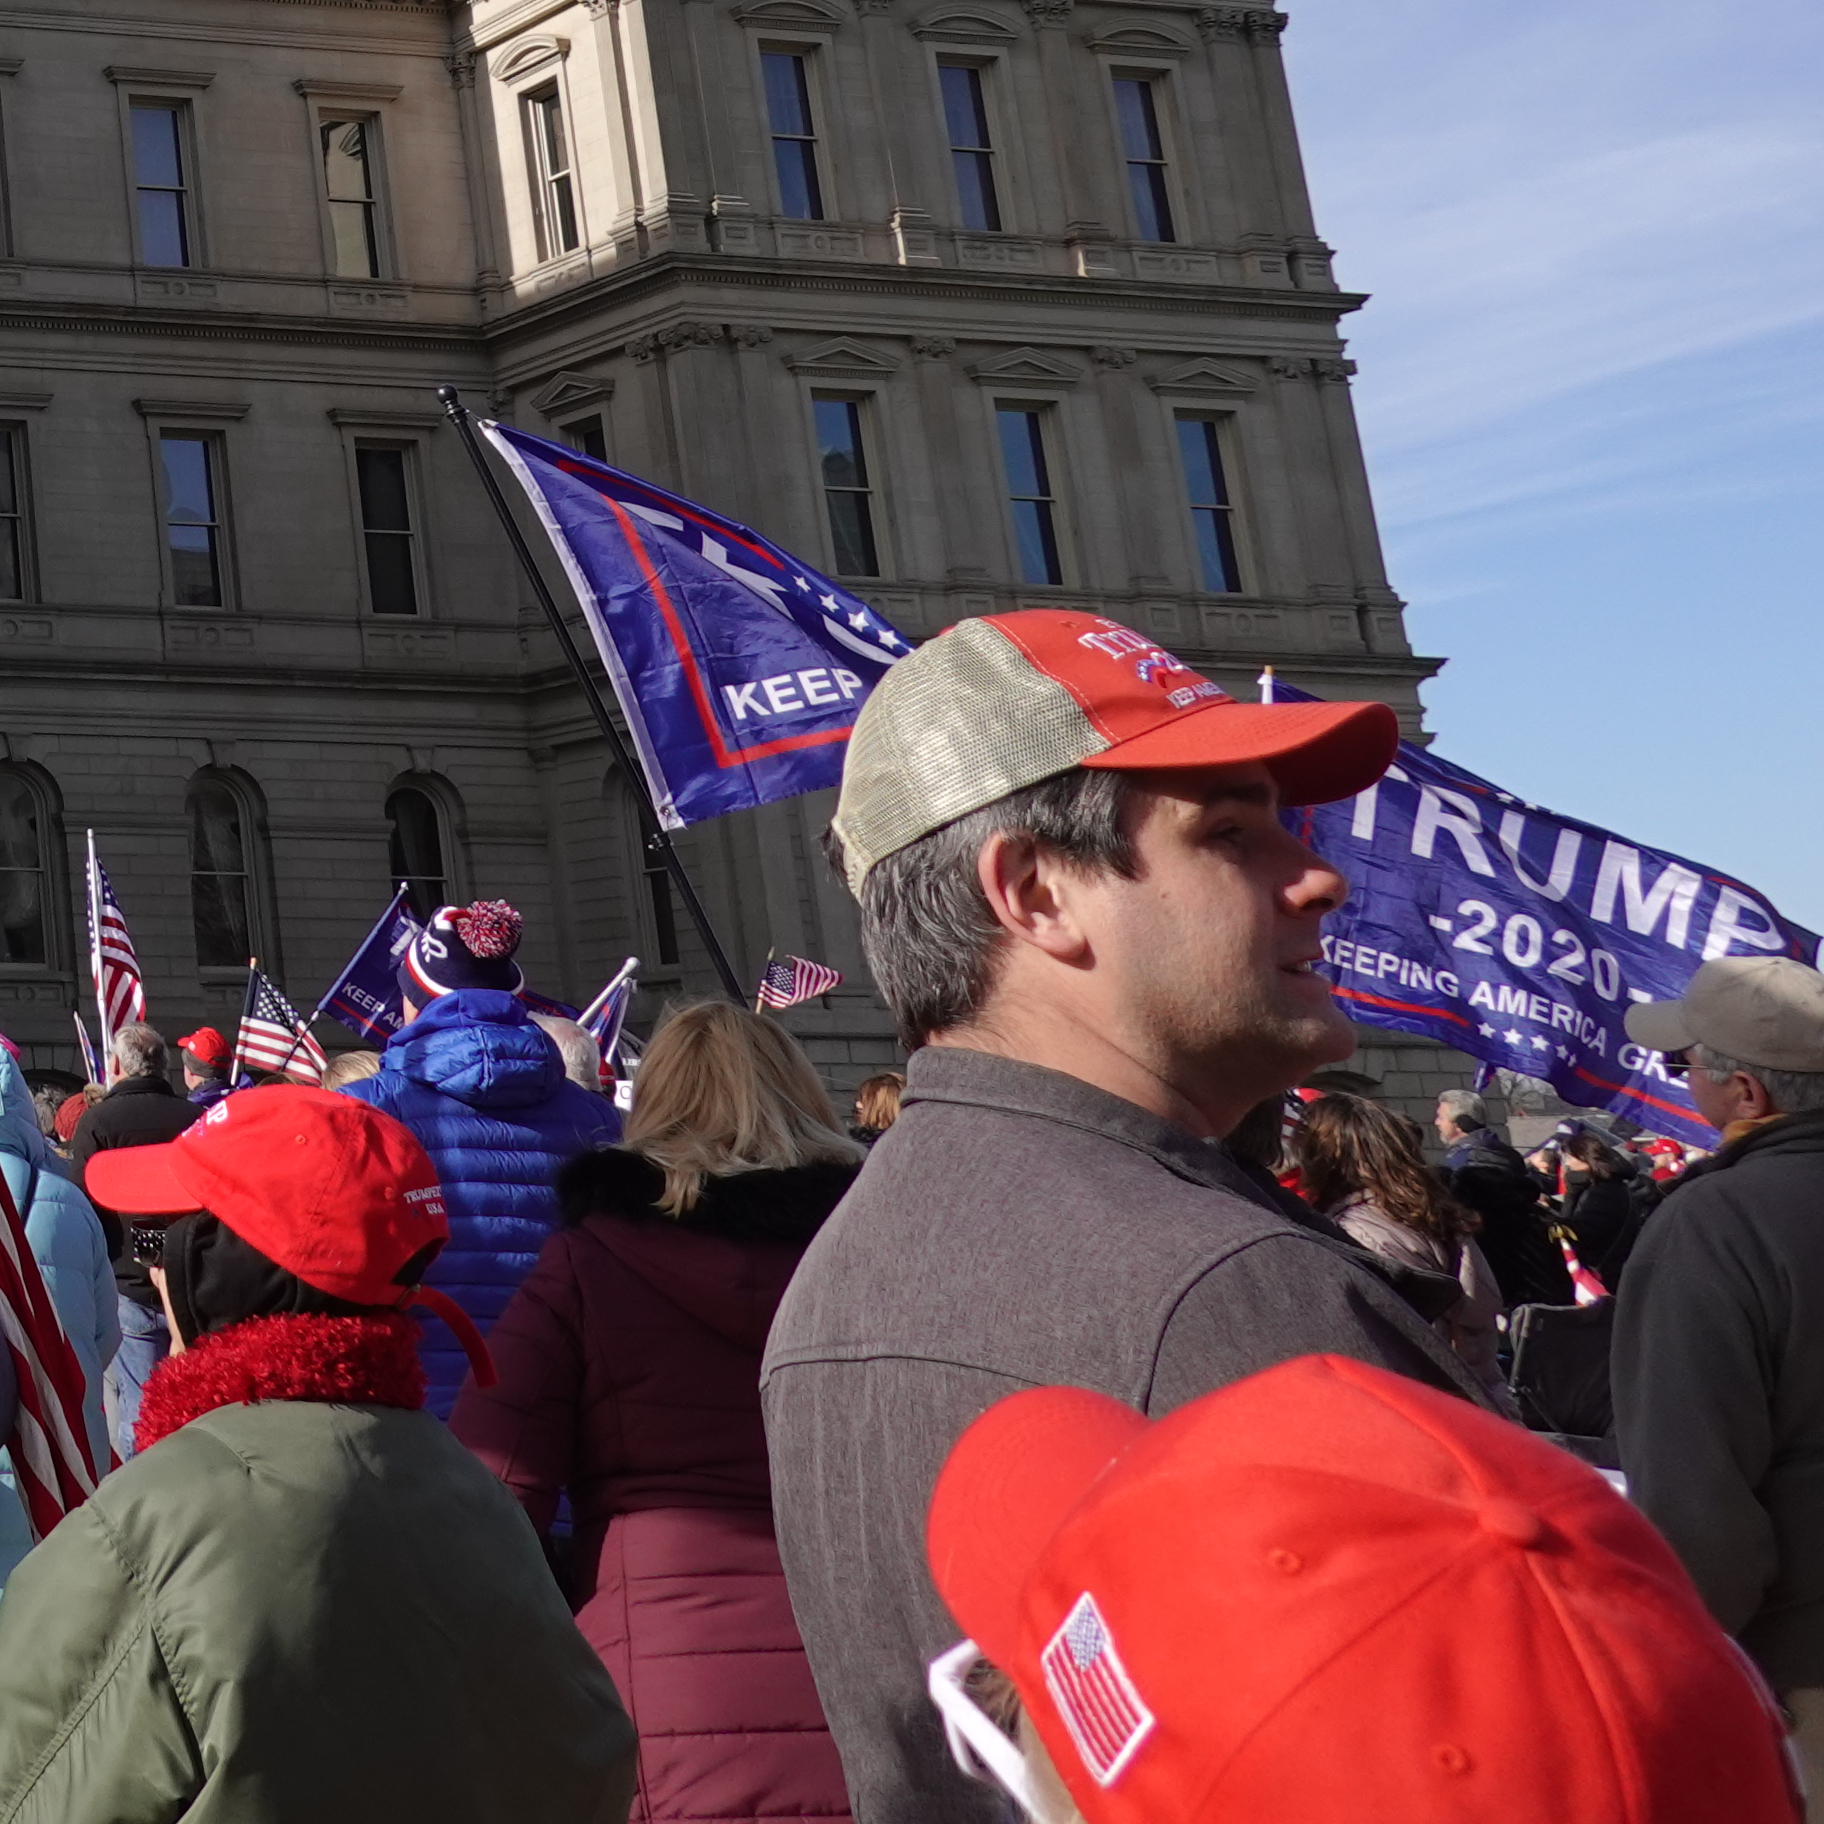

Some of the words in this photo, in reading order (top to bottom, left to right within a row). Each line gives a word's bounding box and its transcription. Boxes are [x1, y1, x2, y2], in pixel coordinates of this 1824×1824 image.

[723, 668, 862, 720] KEEP
[1352, 763, 1786, 961] TRUMP
[1320, 934, 1459, 998] KEEPING
[1468, 980, 1607, 1057] AMERICA
